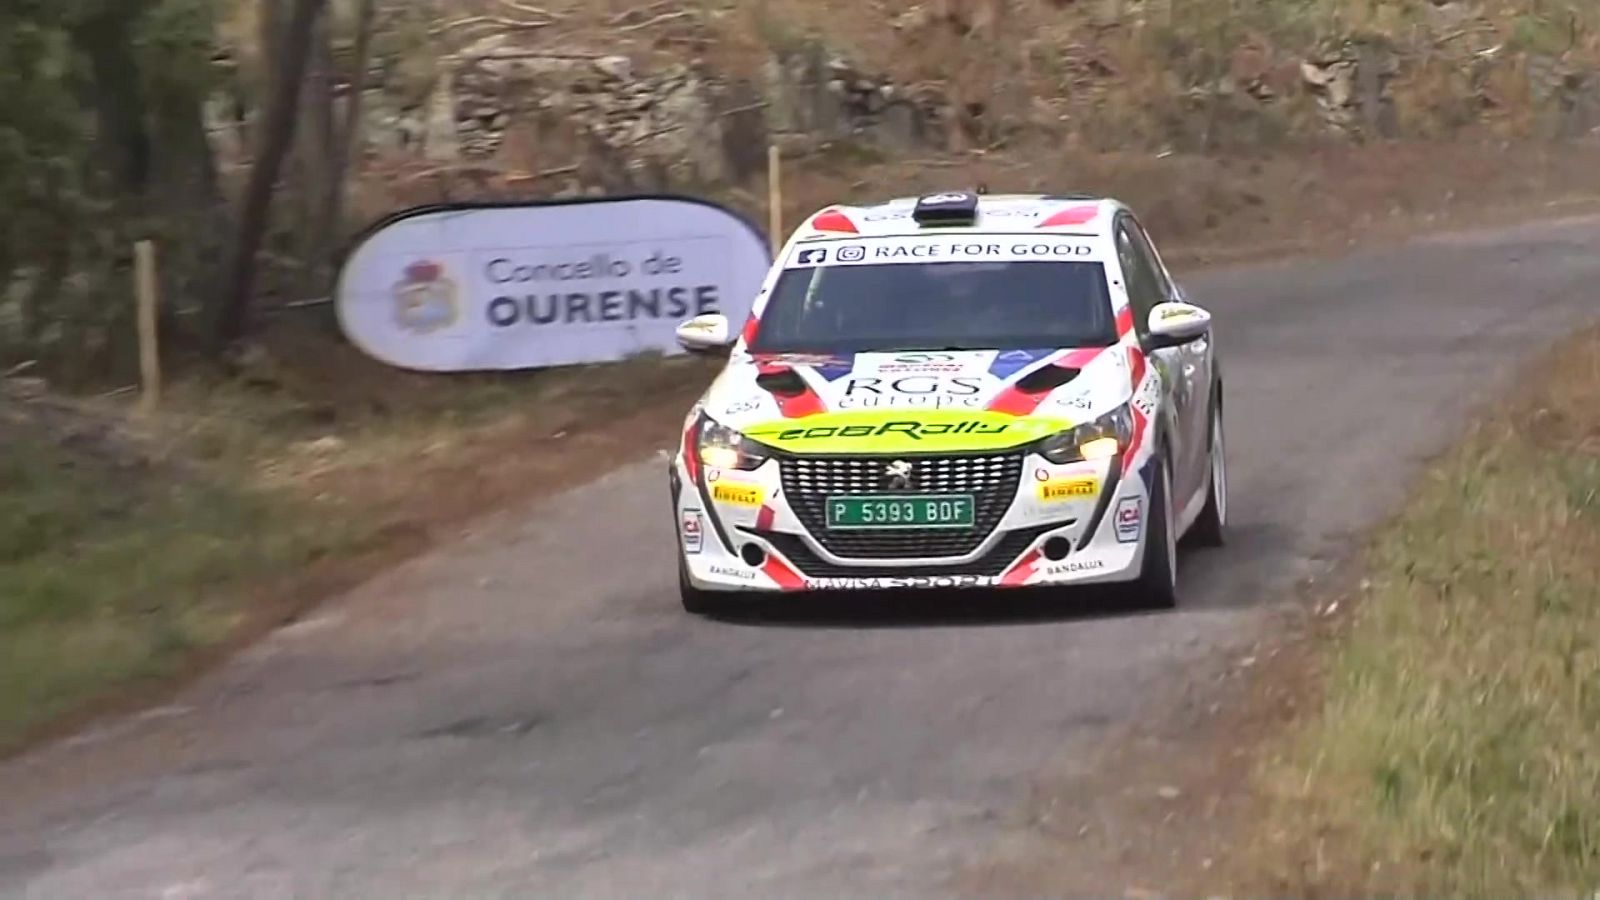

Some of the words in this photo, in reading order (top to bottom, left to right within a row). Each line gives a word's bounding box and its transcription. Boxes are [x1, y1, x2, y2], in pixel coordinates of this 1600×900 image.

[875, 244, 940, 257] RACE
[951, 243, 1001, 257] FOR
[1010, 242, 1092, 256] GOOD
[485, 256, 632, 283] Concello
[641, 250, 683, 275] de
[486, 285, 719, 328] OURENSE
[844, 375, 982, 396] RGS
[838, 395, 980, 409] europe
[834, 503, 847, 521] P
[861, 502, 915, 522] 5393
[926, 502, 967, 522] BDF
[1046, 559, 1105, 575] BANDALUX
